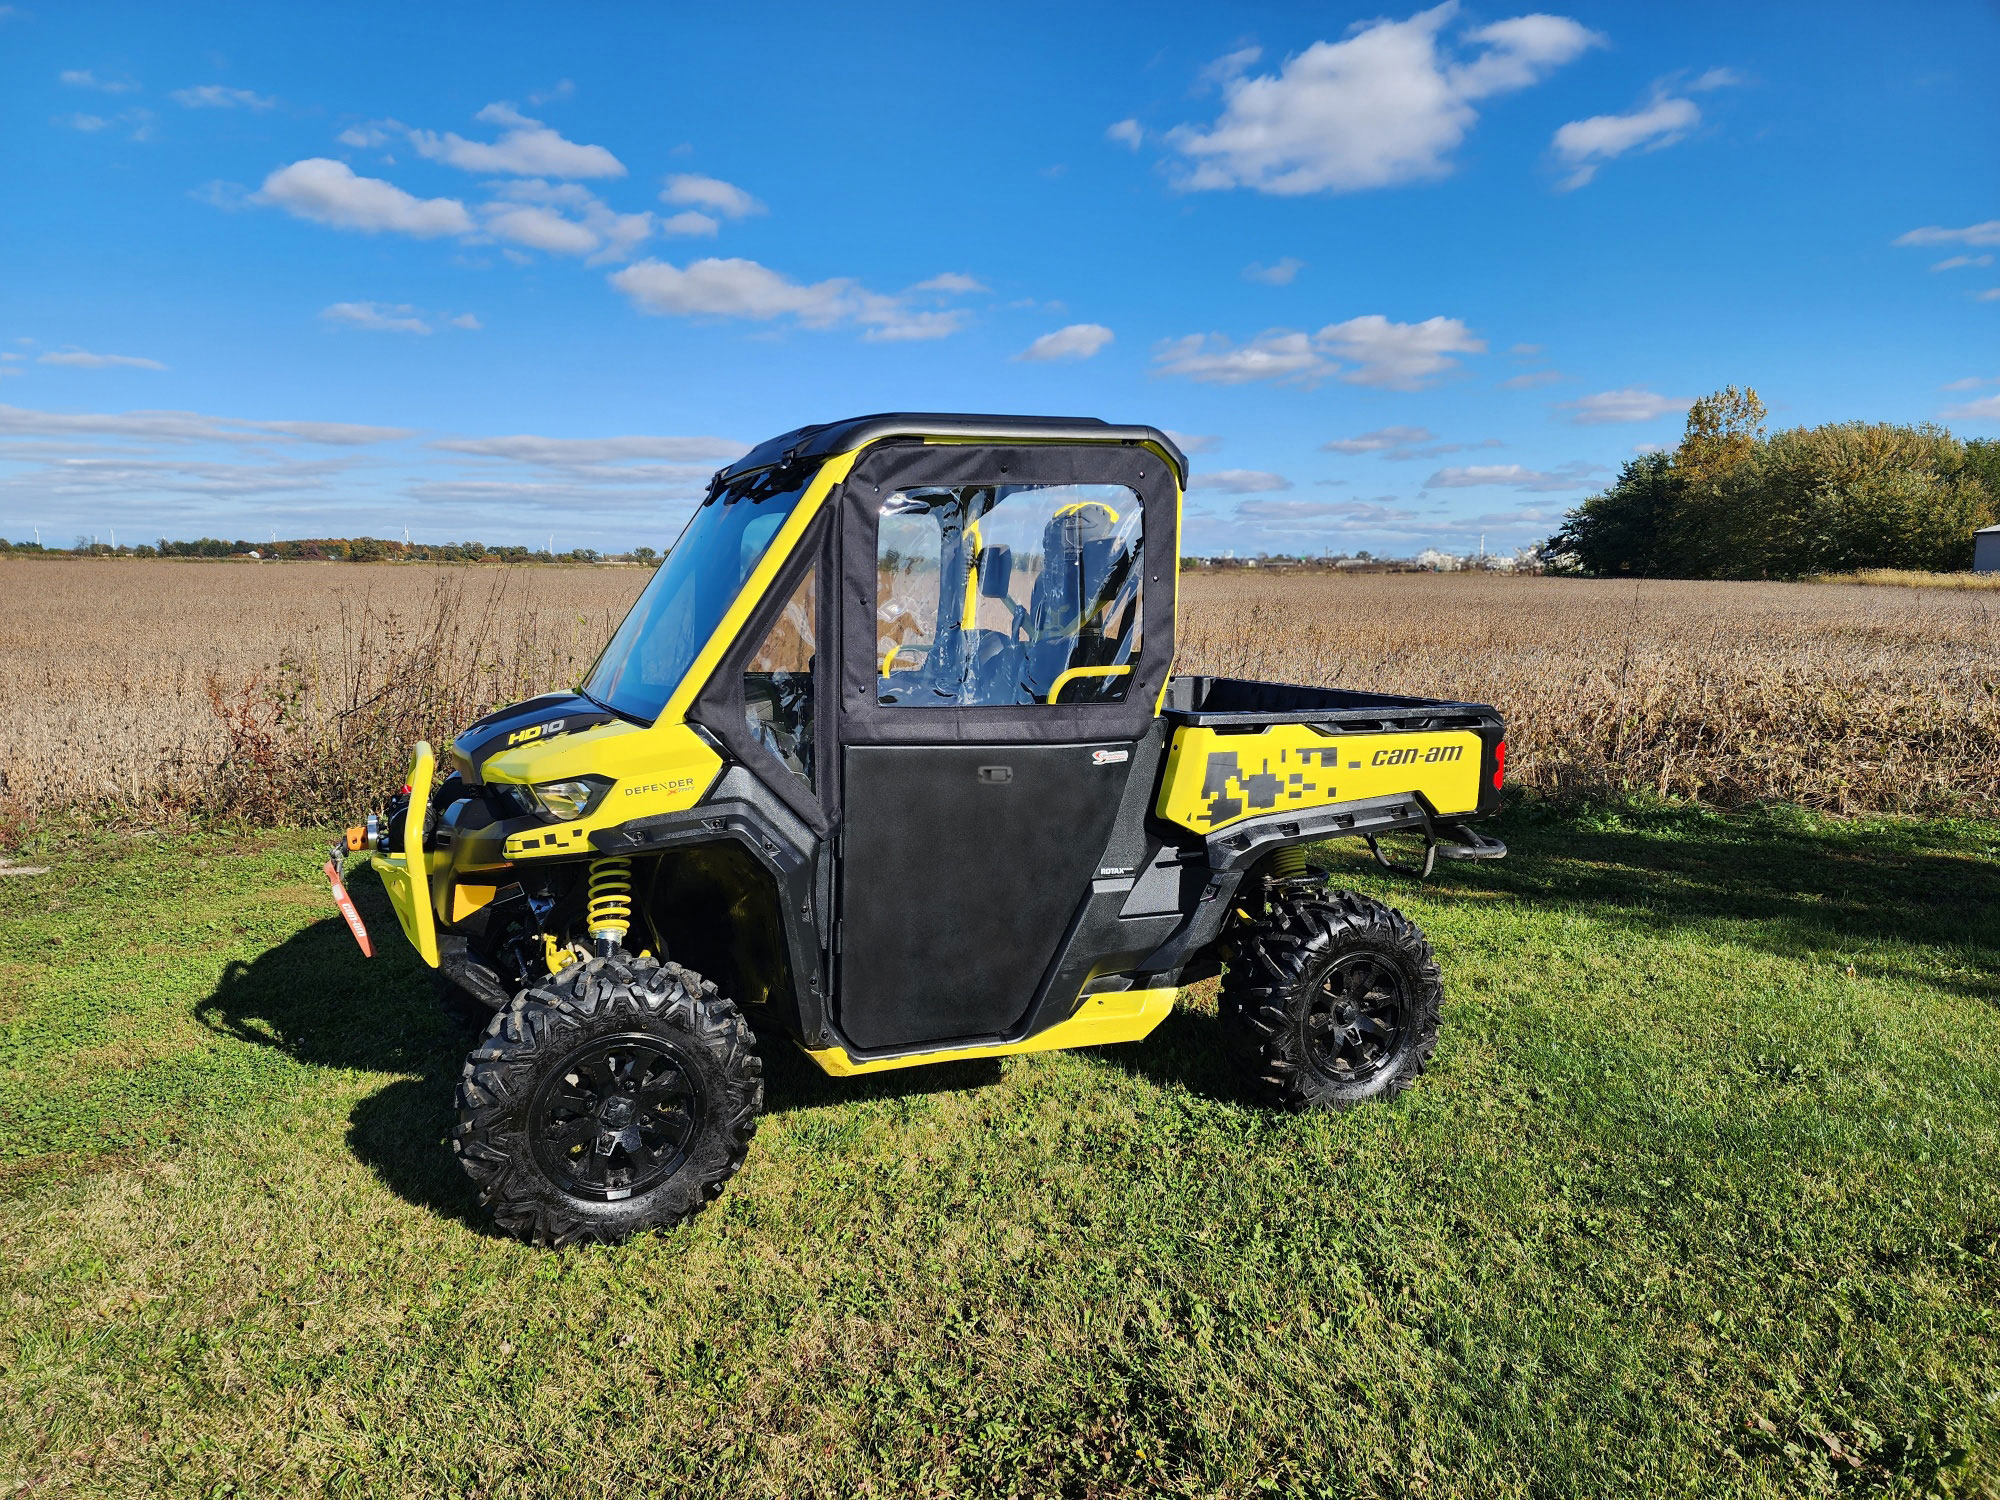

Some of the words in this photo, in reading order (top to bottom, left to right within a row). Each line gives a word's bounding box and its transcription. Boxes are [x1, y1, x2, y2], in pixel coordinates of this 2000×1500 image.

[507, 719, 565, 746] HD10
[1371, 745, 1464, 767] can-am
[625, 778, 694, 796] DEFENDER
[1100, 867, 1125, 875] ROTAX
